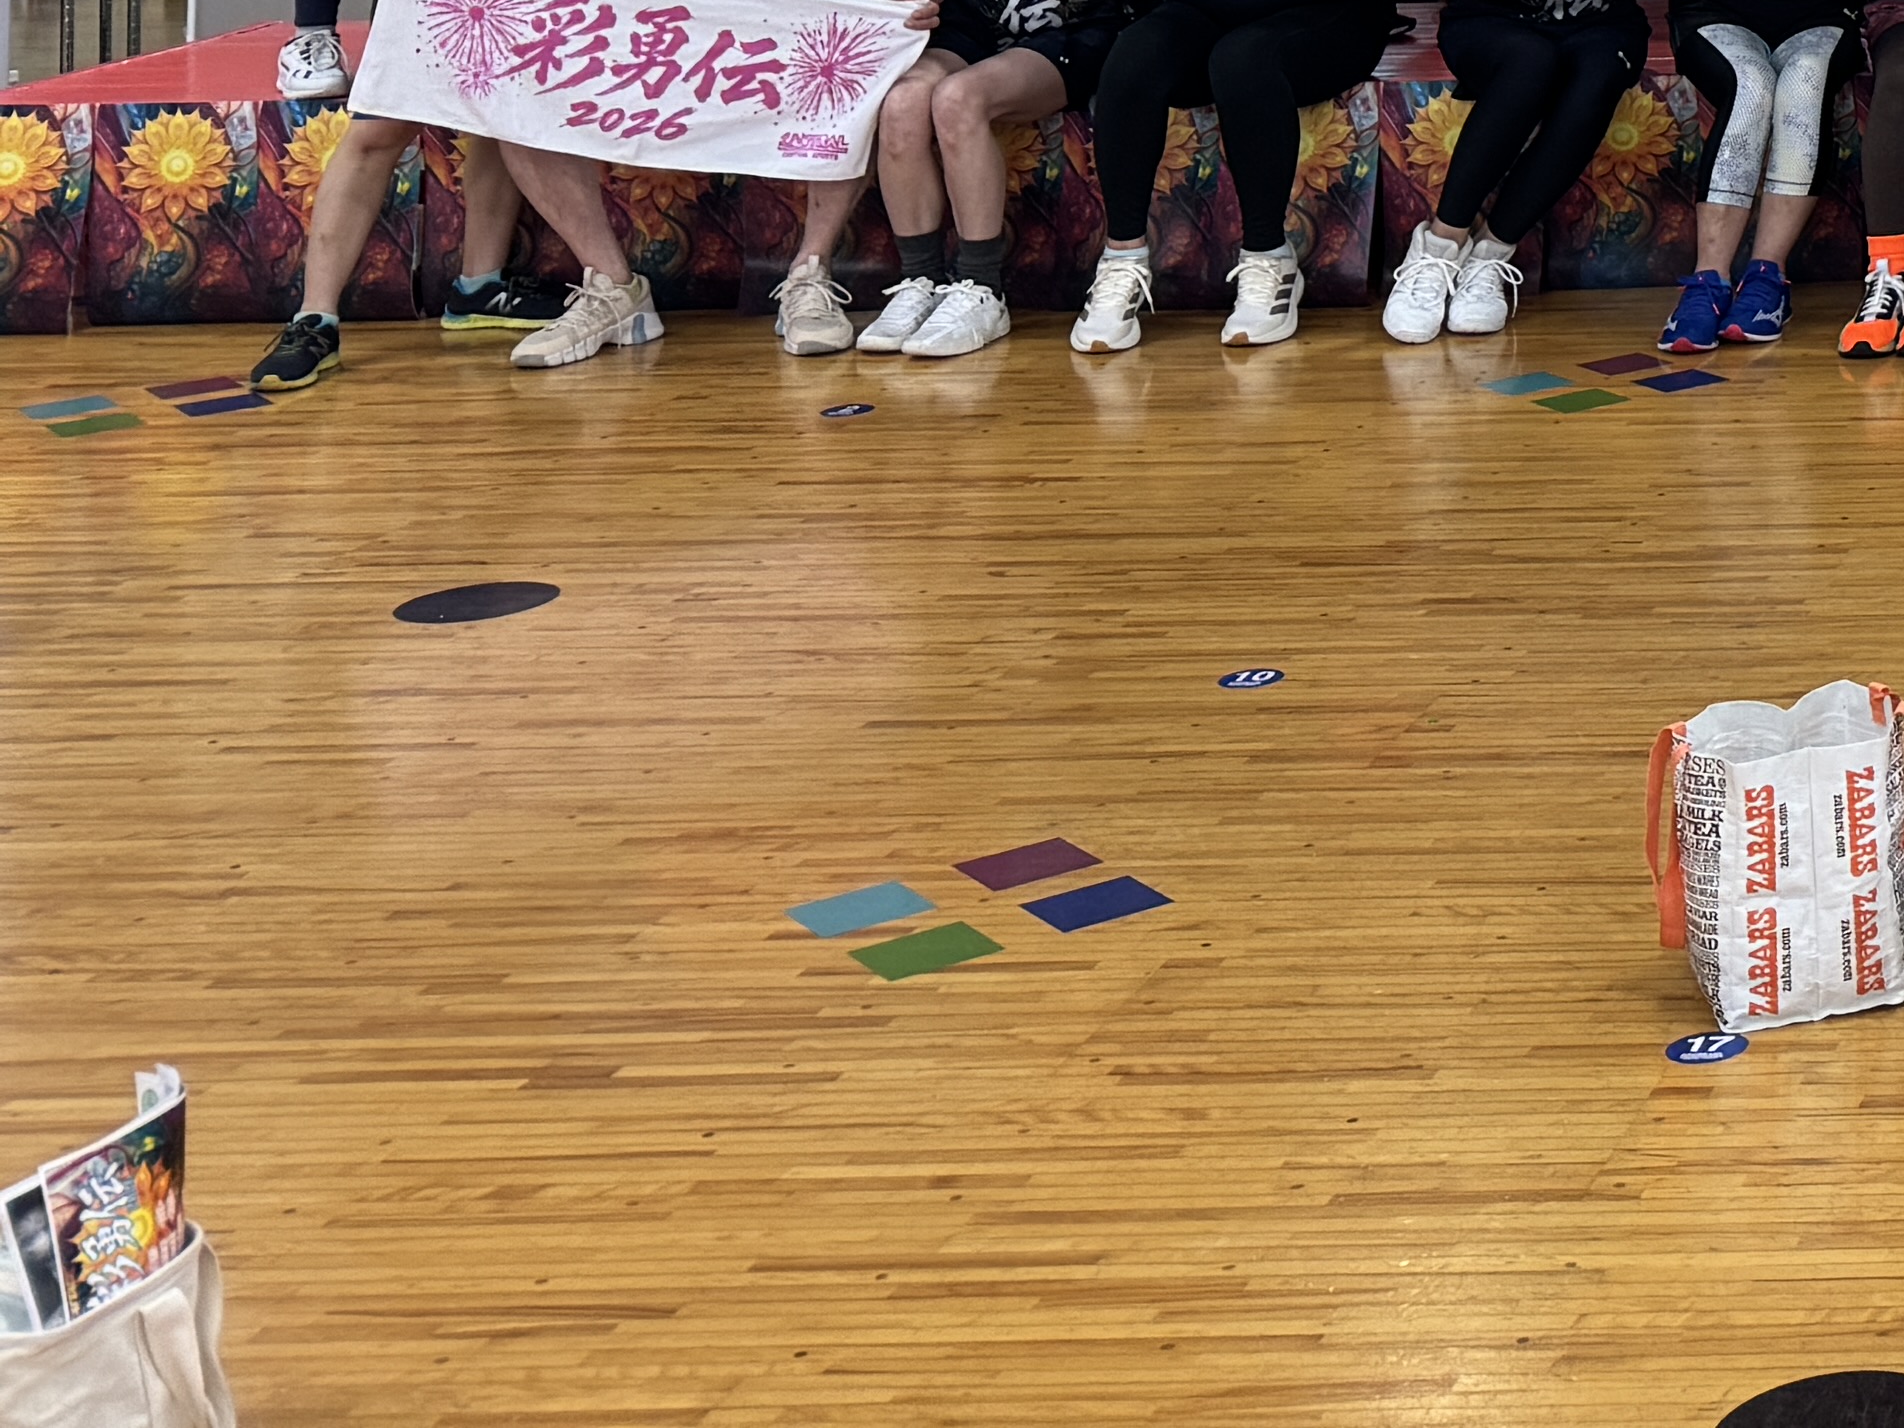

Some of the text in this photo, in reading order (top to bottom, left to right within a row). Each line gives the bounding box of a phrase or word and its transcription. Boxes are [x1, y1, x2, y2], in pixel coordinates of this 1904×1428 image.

[558, 100, 696, 142] 2026
[1234, 670, 1276, 682] 10
[1778, 802, 1789, 868] zabars.com
[1833, 793, 1845, 859] zabars.com
[1782, 927, 1792, 993] zabars.com
[1840, 918, 1853, 982] zabars.com
[1686, 1033, 1736, 1053] 17
